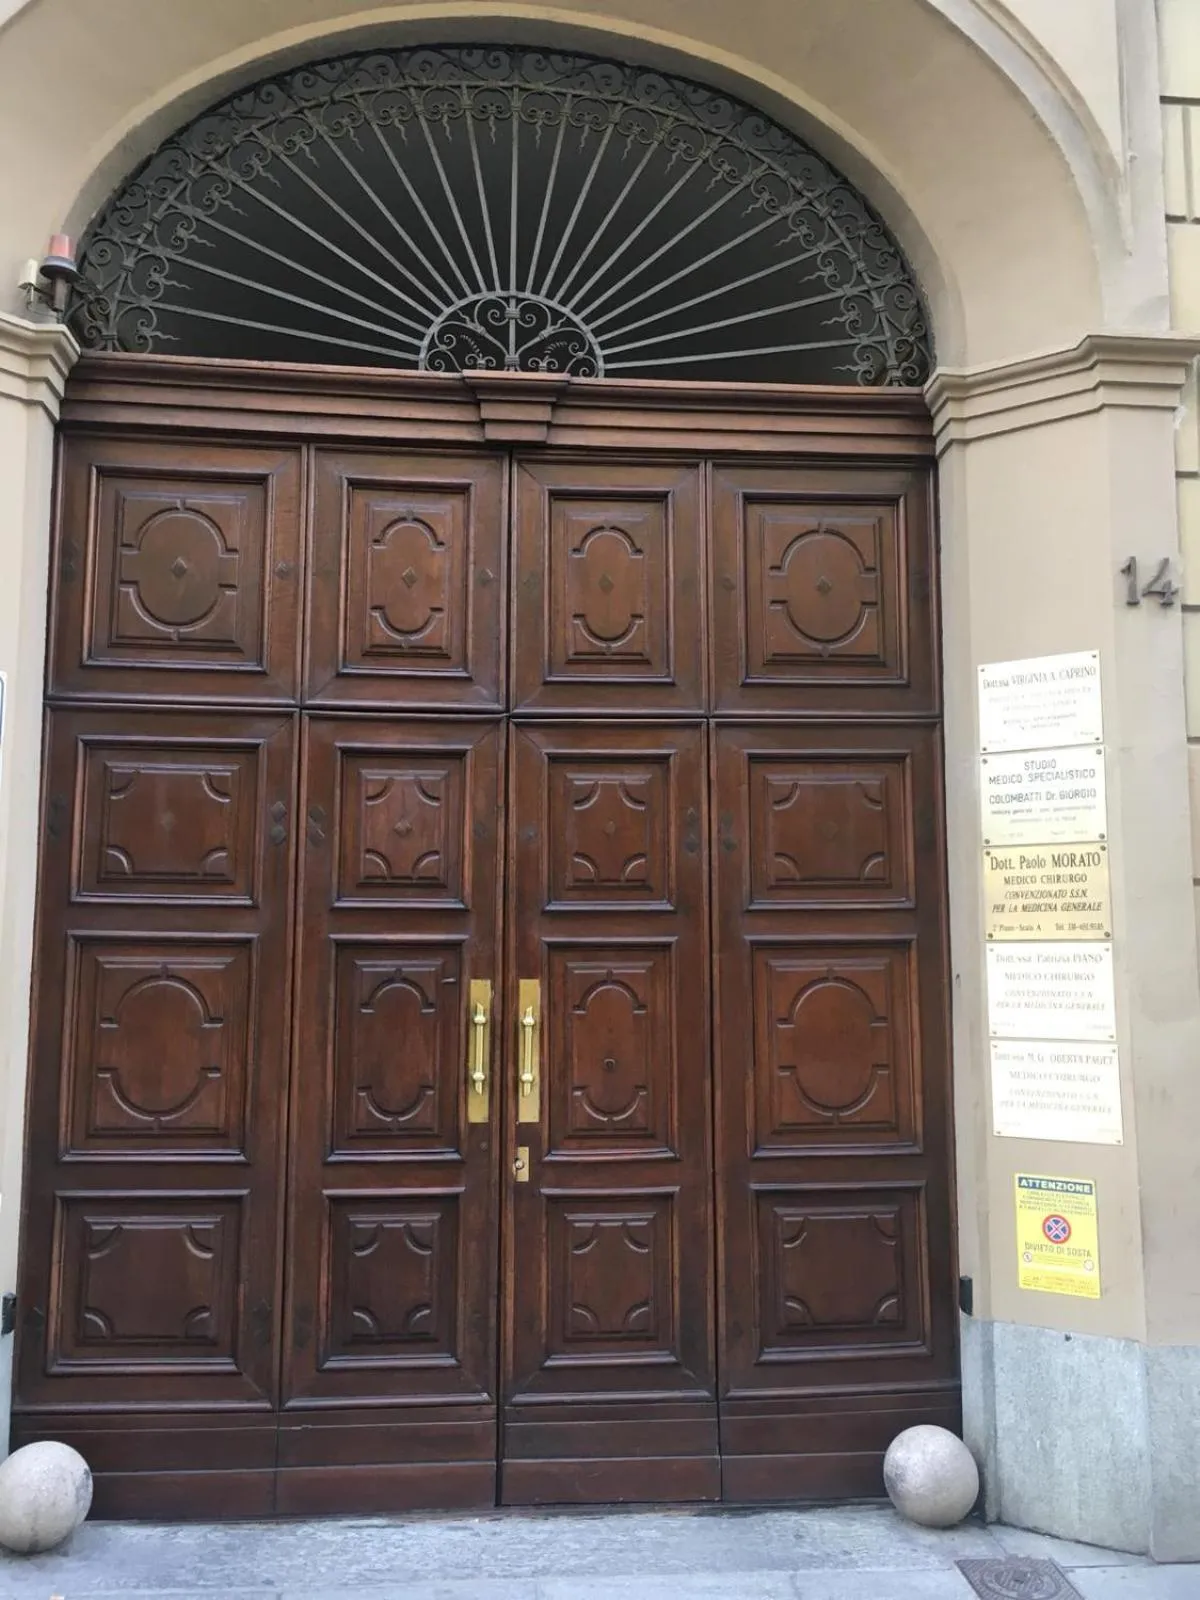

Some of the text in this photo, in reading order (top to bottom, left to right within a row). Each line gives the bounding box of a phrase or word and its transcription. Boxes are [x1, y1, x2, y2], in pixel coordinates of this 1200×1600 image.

[1120, 556, 1179, 606] 14
[1011, 673, 1048, 685] VIRGINIA
[1059, 666, 1096, 680] CAPRINO
[1024, 759, 1056, 770] STUDIO
[988, 769, 1096, 784] MEDICO SPECIALISTICO
[989, 788, 1096, 804] COLOMBATTI Dr. GIORGIO
[990, 852, 1101, 870] Dott. Paolo MORATO
[1003, 873, 1087, 885] MEDICO CHIRURGO
[1005, 889, 1067, 899] CONVENZIONATO
[992, 901, 1102, 913] PER LA MEDICINA GENERALE
[1020, 1179, 1091, 1193] ATTENZIONE
[1024, 1241, 1092, 1257] DIVIETO DI SOSTA
